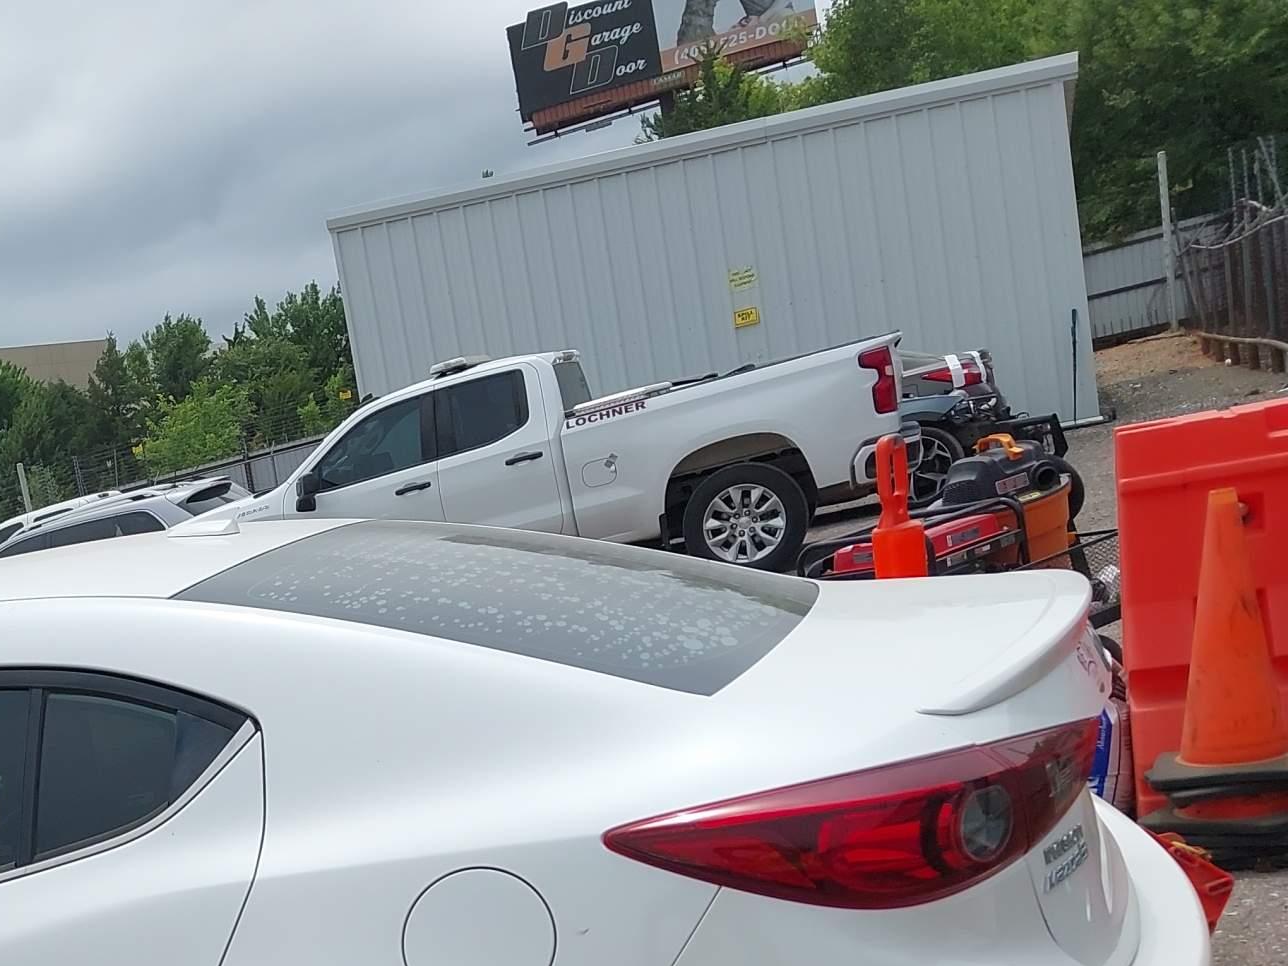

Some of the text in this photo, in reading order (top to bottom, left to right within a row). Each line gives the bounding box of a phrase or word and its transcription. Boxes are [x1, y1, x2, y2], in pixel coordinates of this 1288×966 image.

[543, 22, 642, 72] Garage
[570, 45, 647, 95] Door
[565, 400, 647, 430] LOCHNER
